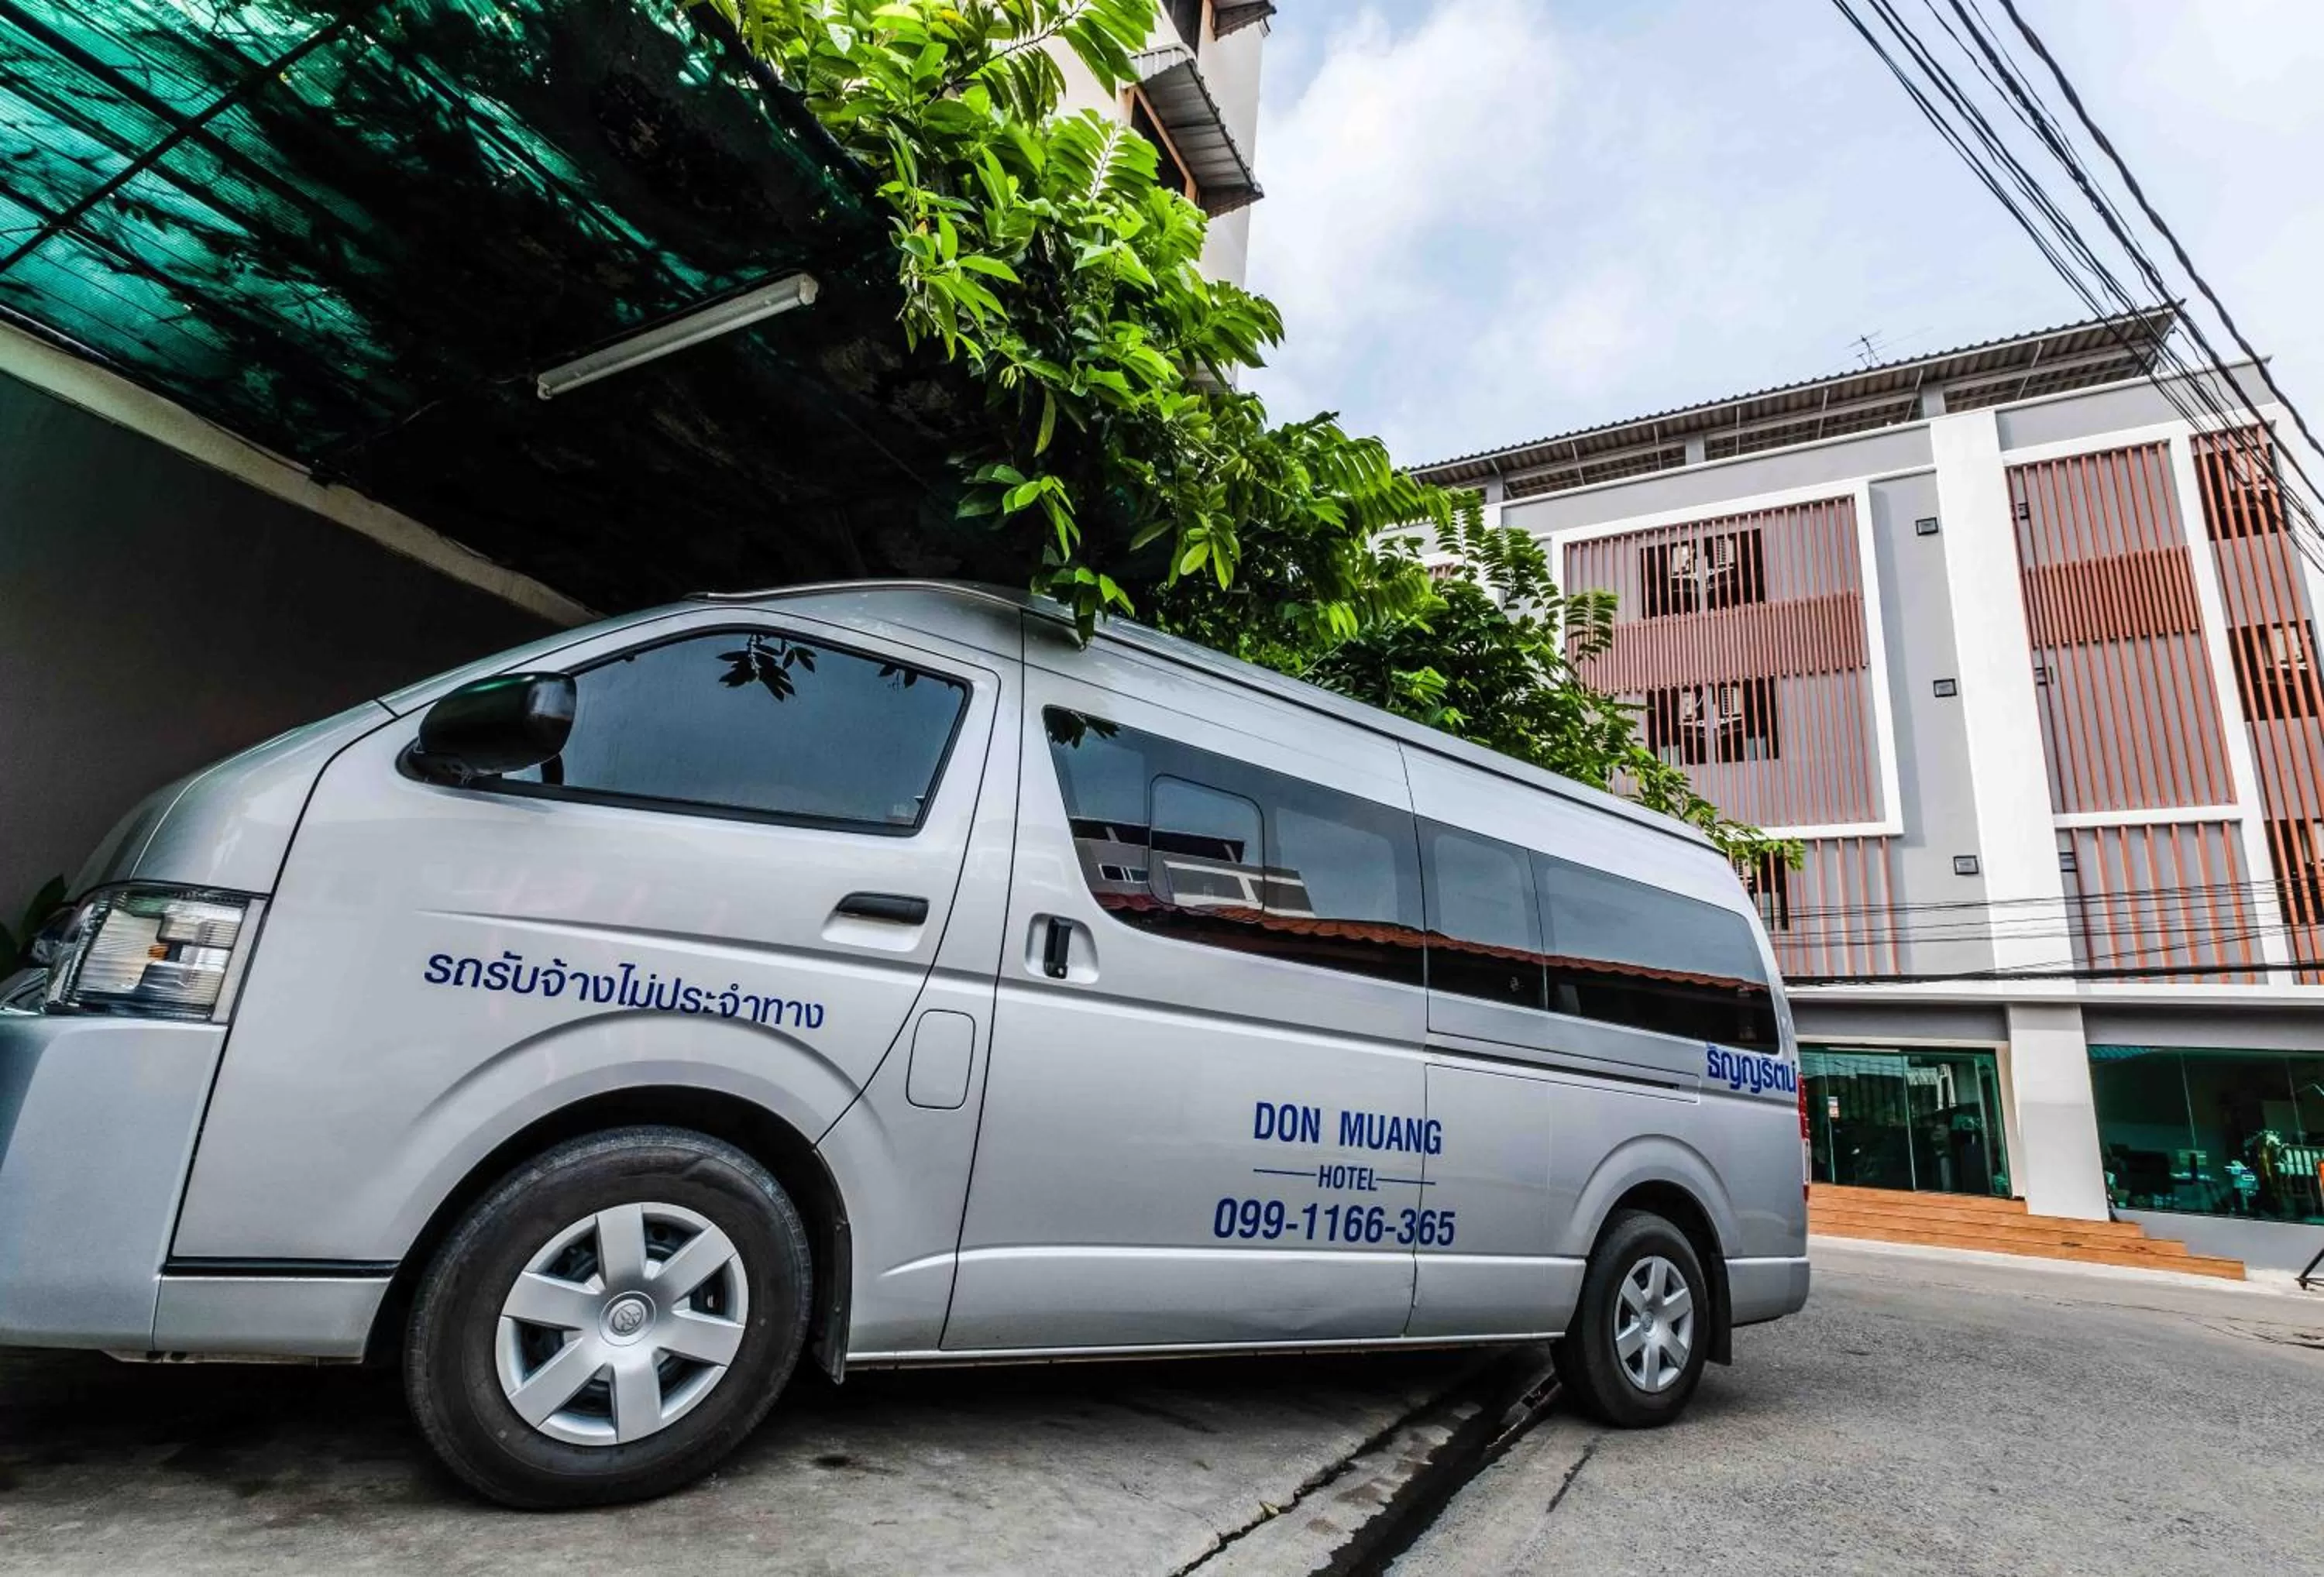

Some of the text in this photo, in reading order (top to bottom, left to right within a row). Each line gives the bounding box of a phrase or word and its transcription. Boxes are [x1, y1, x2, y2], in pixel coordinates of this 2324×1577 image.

[424, 950, 824, 1029] รถรับจ้างไม่ประจำทาง
[1253, 1101, 1442, 1155] DON MUANG
[1318, 1165, 1378, 1191] HOTEL
[1213, 1197, 1456, 1245] 099-1166-365
